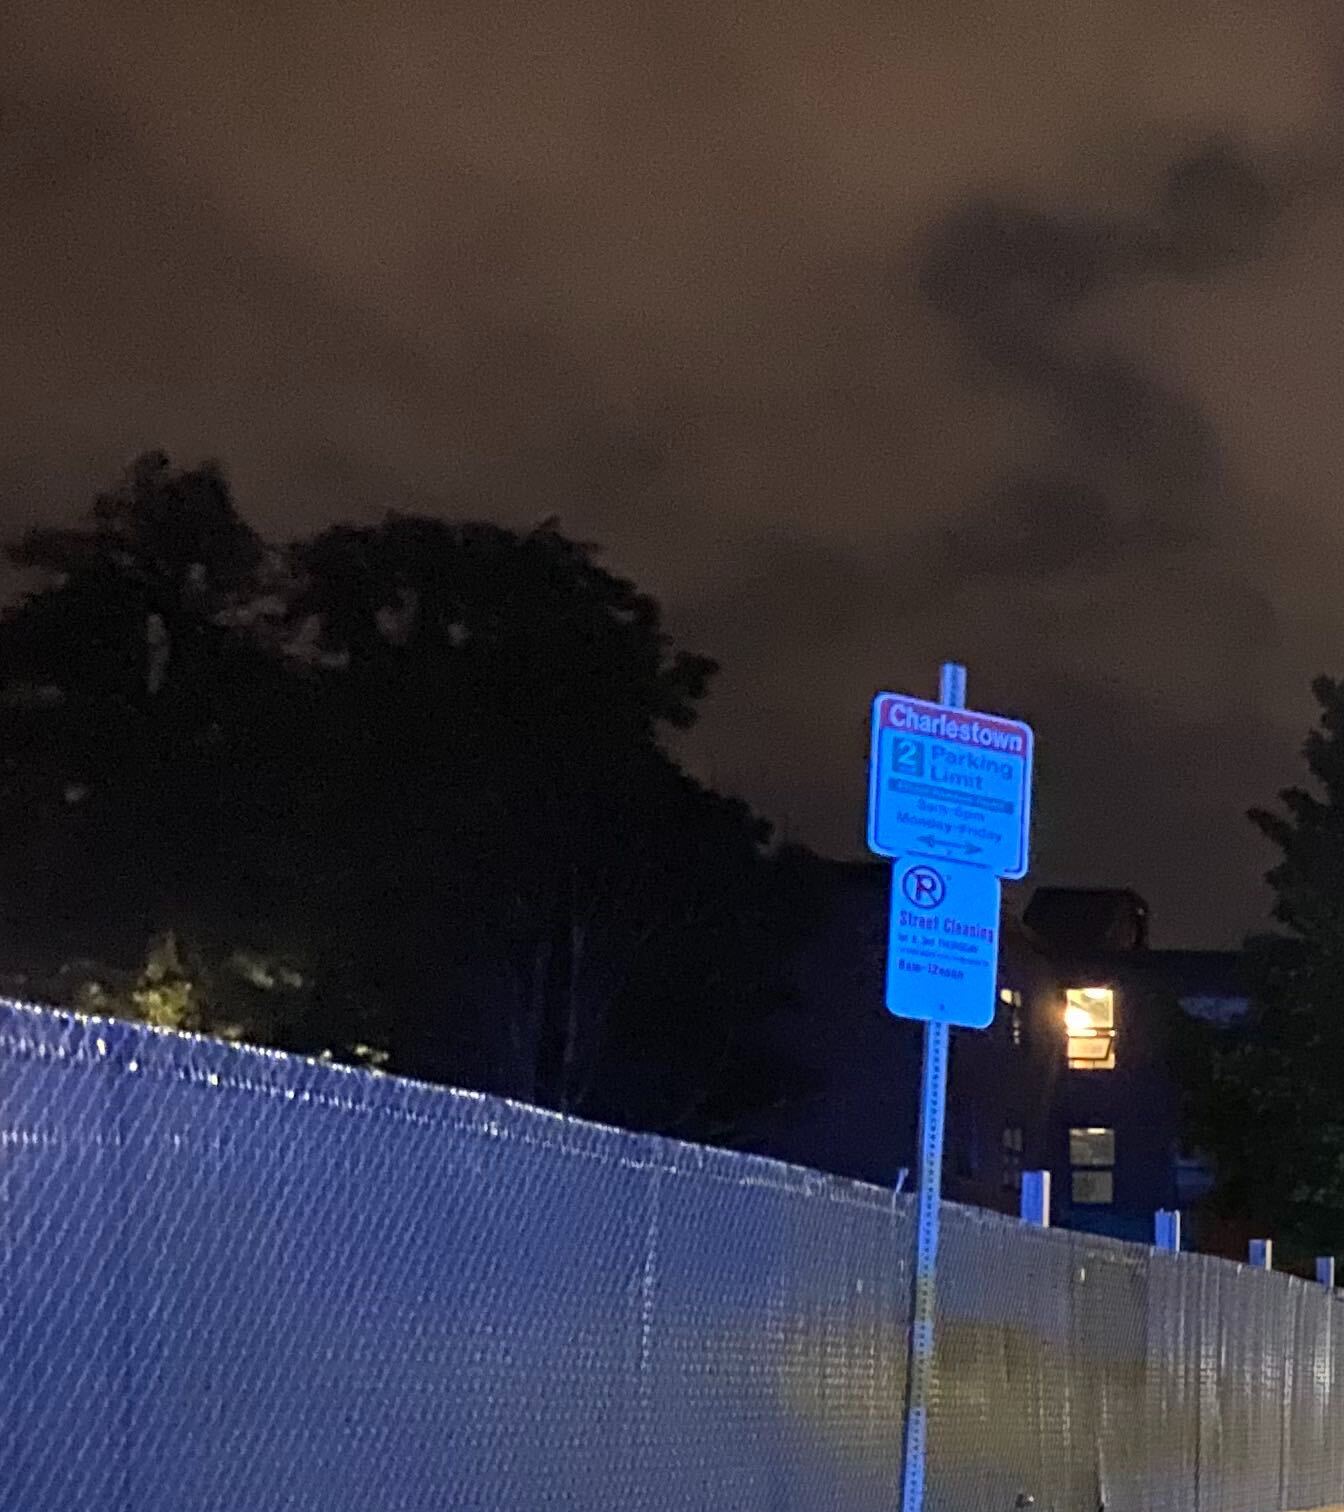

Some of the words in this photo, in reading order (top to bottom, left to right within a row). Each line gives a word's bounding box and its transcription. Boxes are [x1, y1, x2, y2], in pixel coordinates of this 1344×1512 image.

[889, 703, 1022, 751] Charlestown
[898, 740, 916, 765] 2
[931, 744, 1014, 781] Parking
[931, 765, 983, 790] Limit
[899, 910, 938, 930] Street
[943, 917, 994, 944] Cleaning
